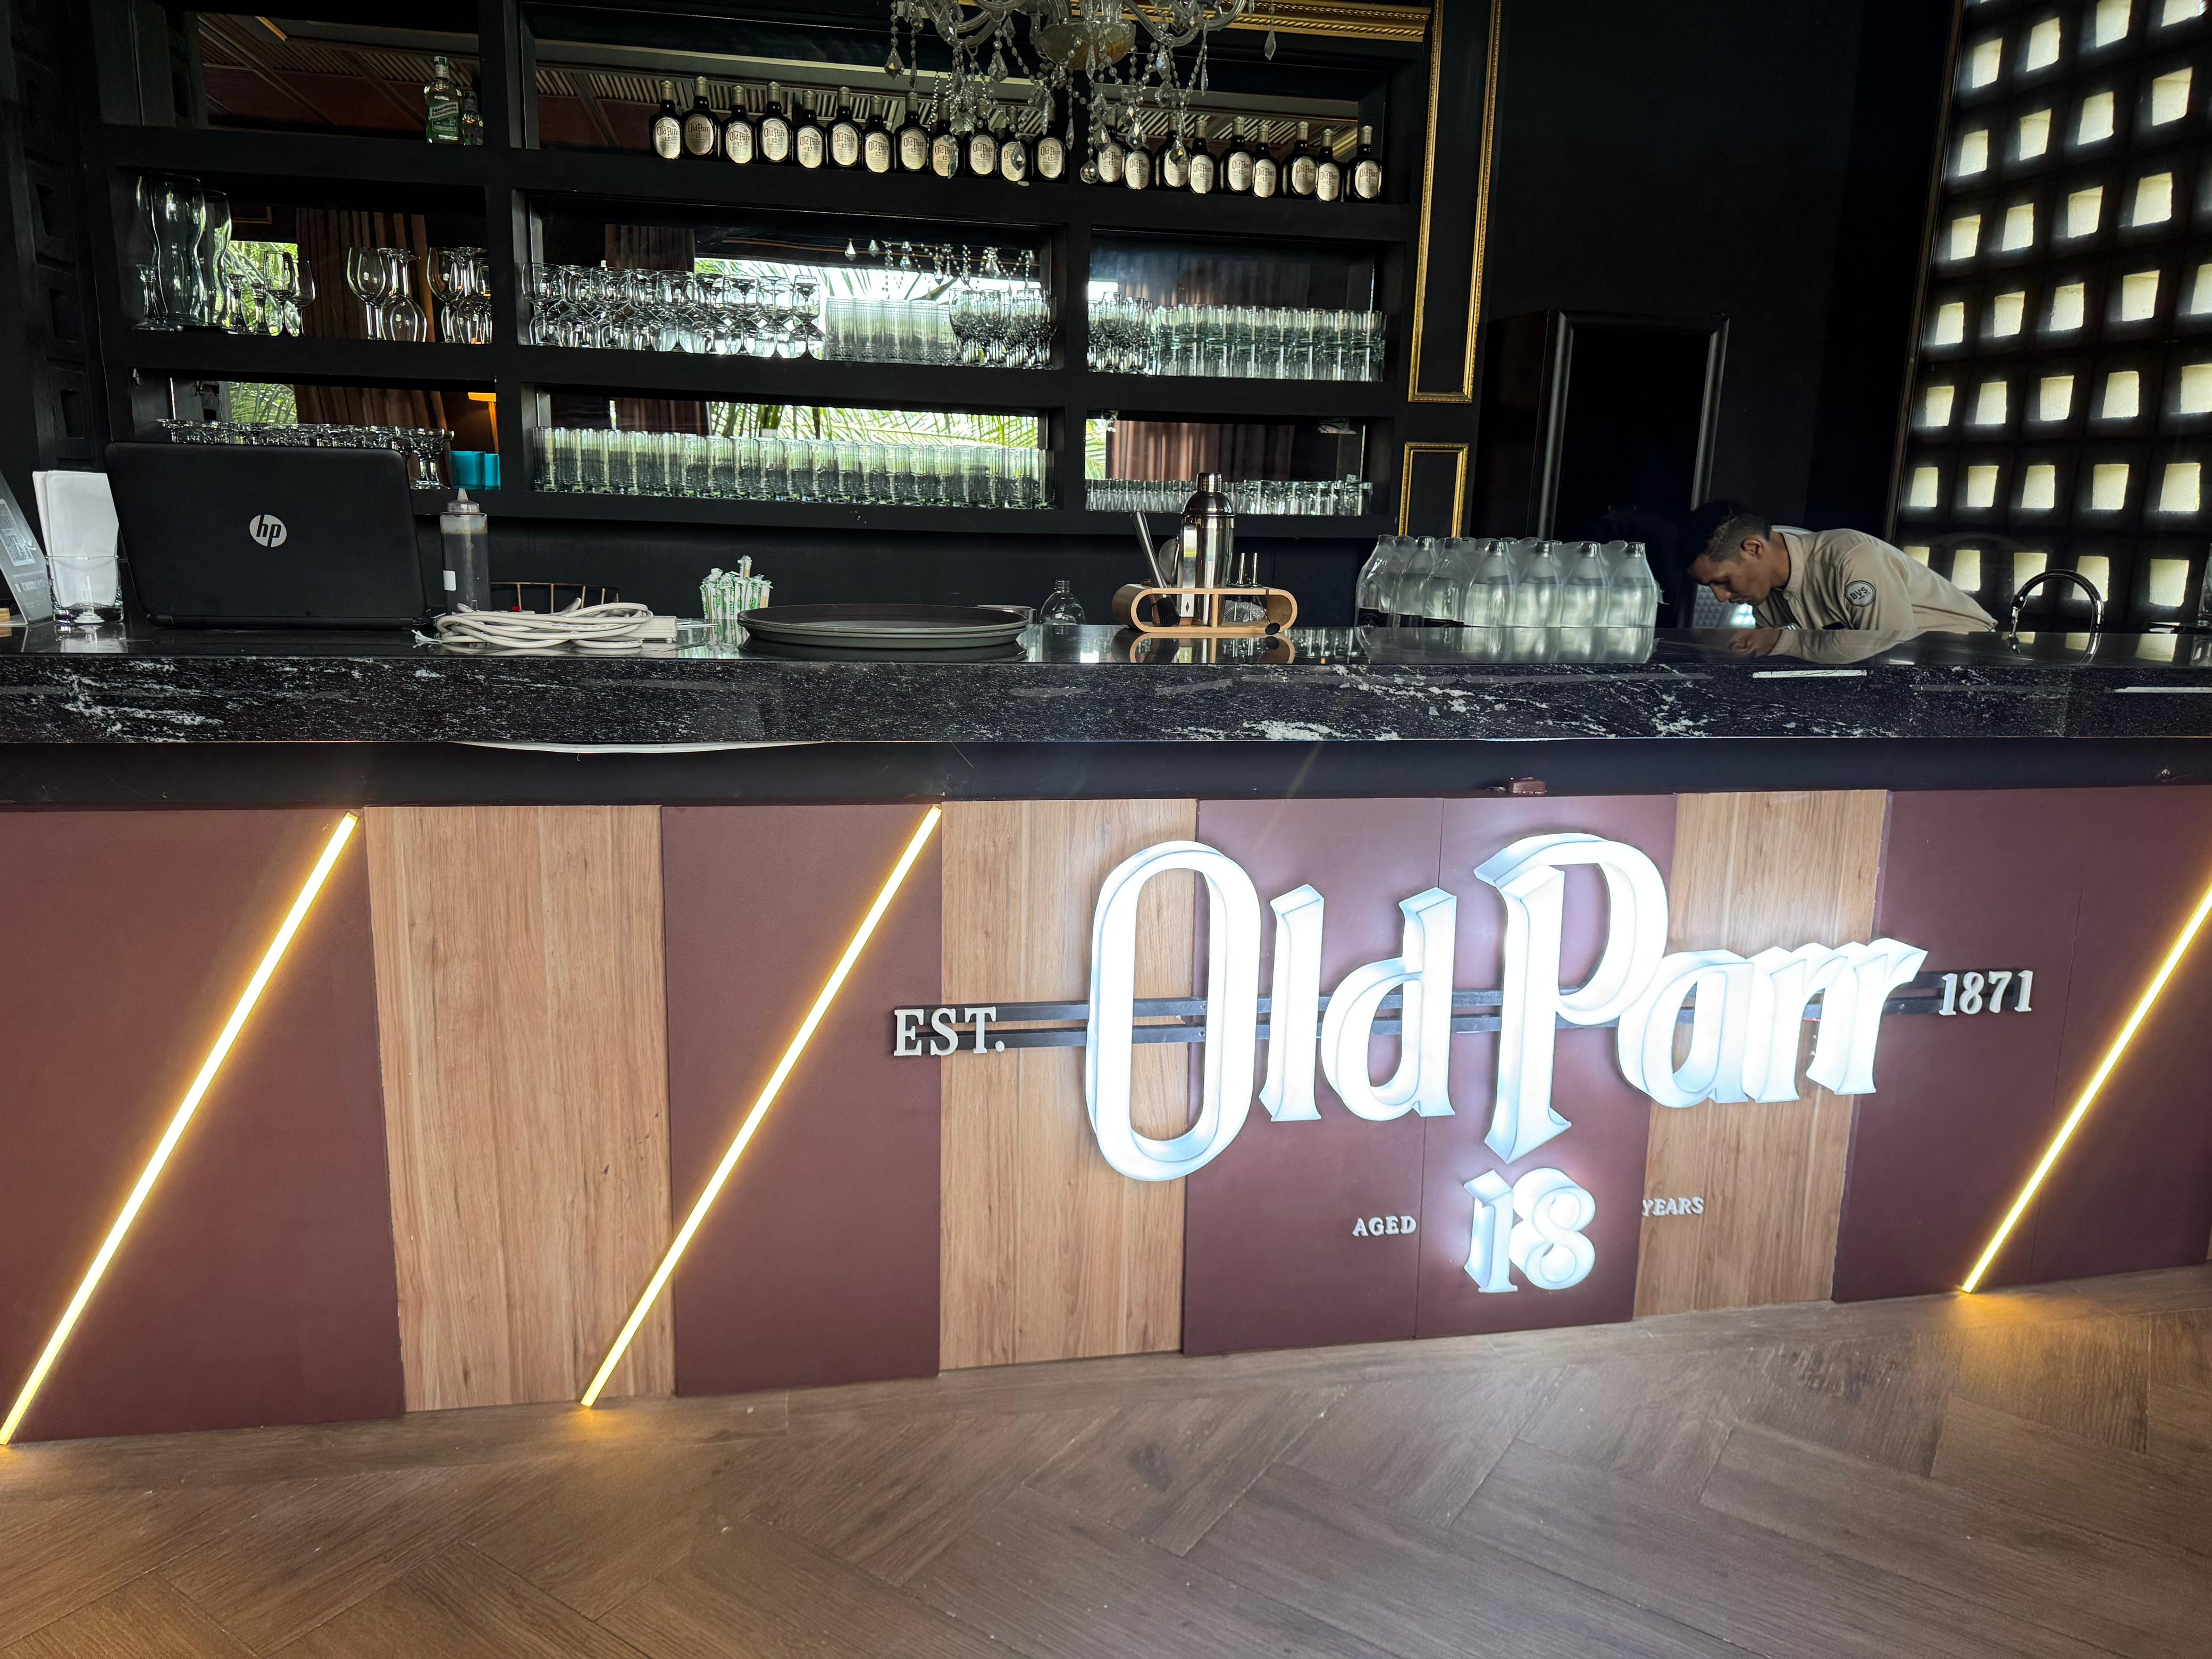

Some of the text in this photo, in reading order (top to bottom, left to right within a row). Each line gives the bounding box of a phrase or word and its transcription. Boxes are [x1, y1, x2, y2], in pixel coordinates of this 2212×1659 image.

[657, 127, 678, 136] Old Parr
[688, 123, 709, 132] Old Parr
[764, 128, 785, 137] Old Parr
[730, 132, 751, 141] Old Parr
[800, 136, 821, 146] Old Parr
[834, 133, 855, 143] Old Parr
[868, 141, 889, 151] Old Parr
[904, 137, 924, 147] Old Parr
[935, 146, 943, 155] Old
[973, 143, 993, 152] Old Parr
[256, 514, 282, 547] hp
[1850, 586, 1867, 599] BVS
[894, 833, 2034, 1182] EST. Old Parr 1871
[1352, 1167, 1704, 1293] AGED 18 YEARS
